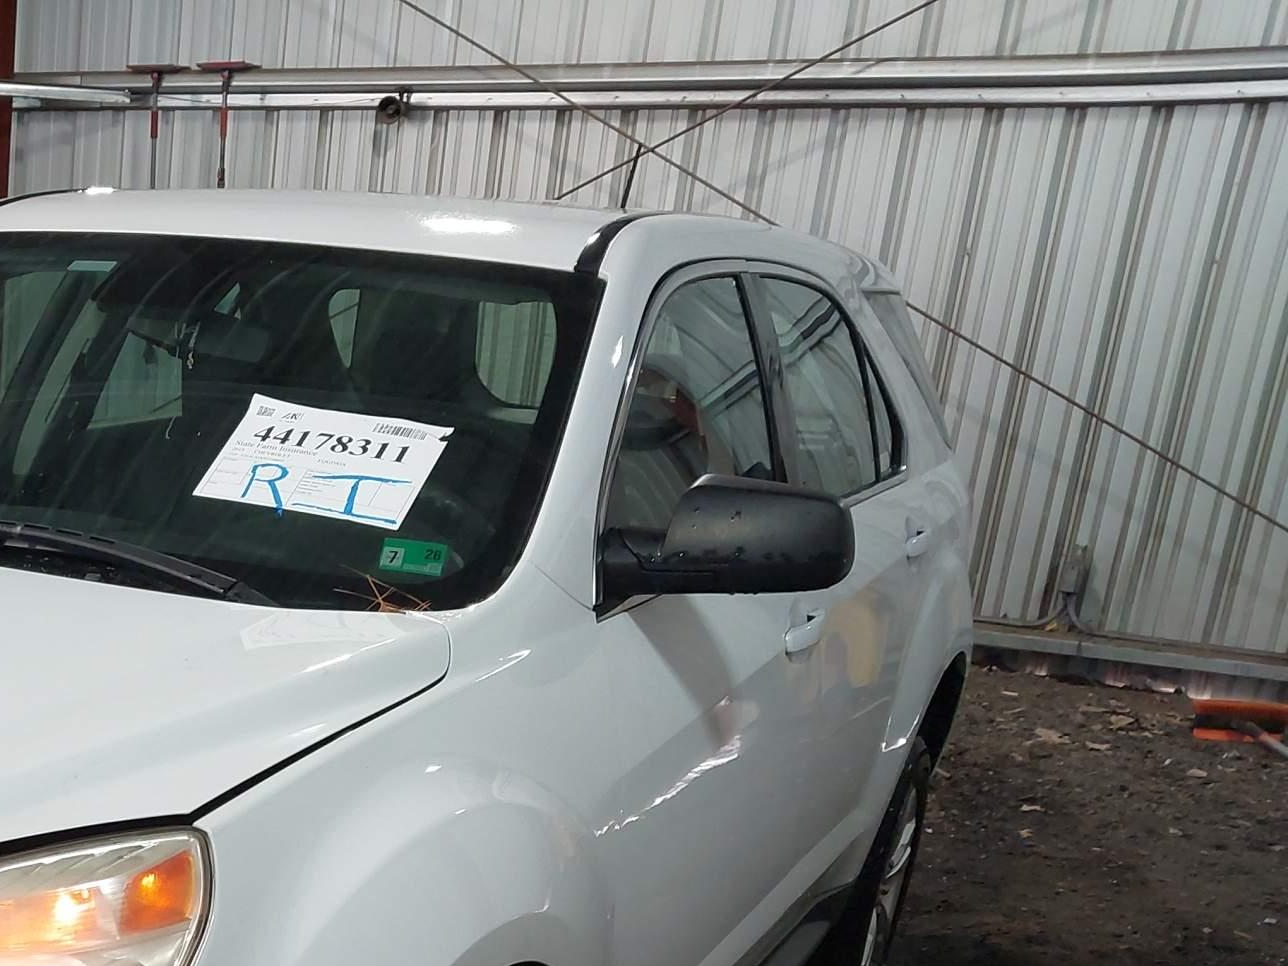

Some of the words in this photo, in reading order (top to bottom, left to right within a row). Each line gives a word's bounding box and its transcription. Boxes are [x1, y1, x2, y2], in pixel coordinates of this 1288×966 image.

[253, 425, 411, 464] 44178311
[241, 463, 289, 516] R
[388, 550, 399, 563] 7
